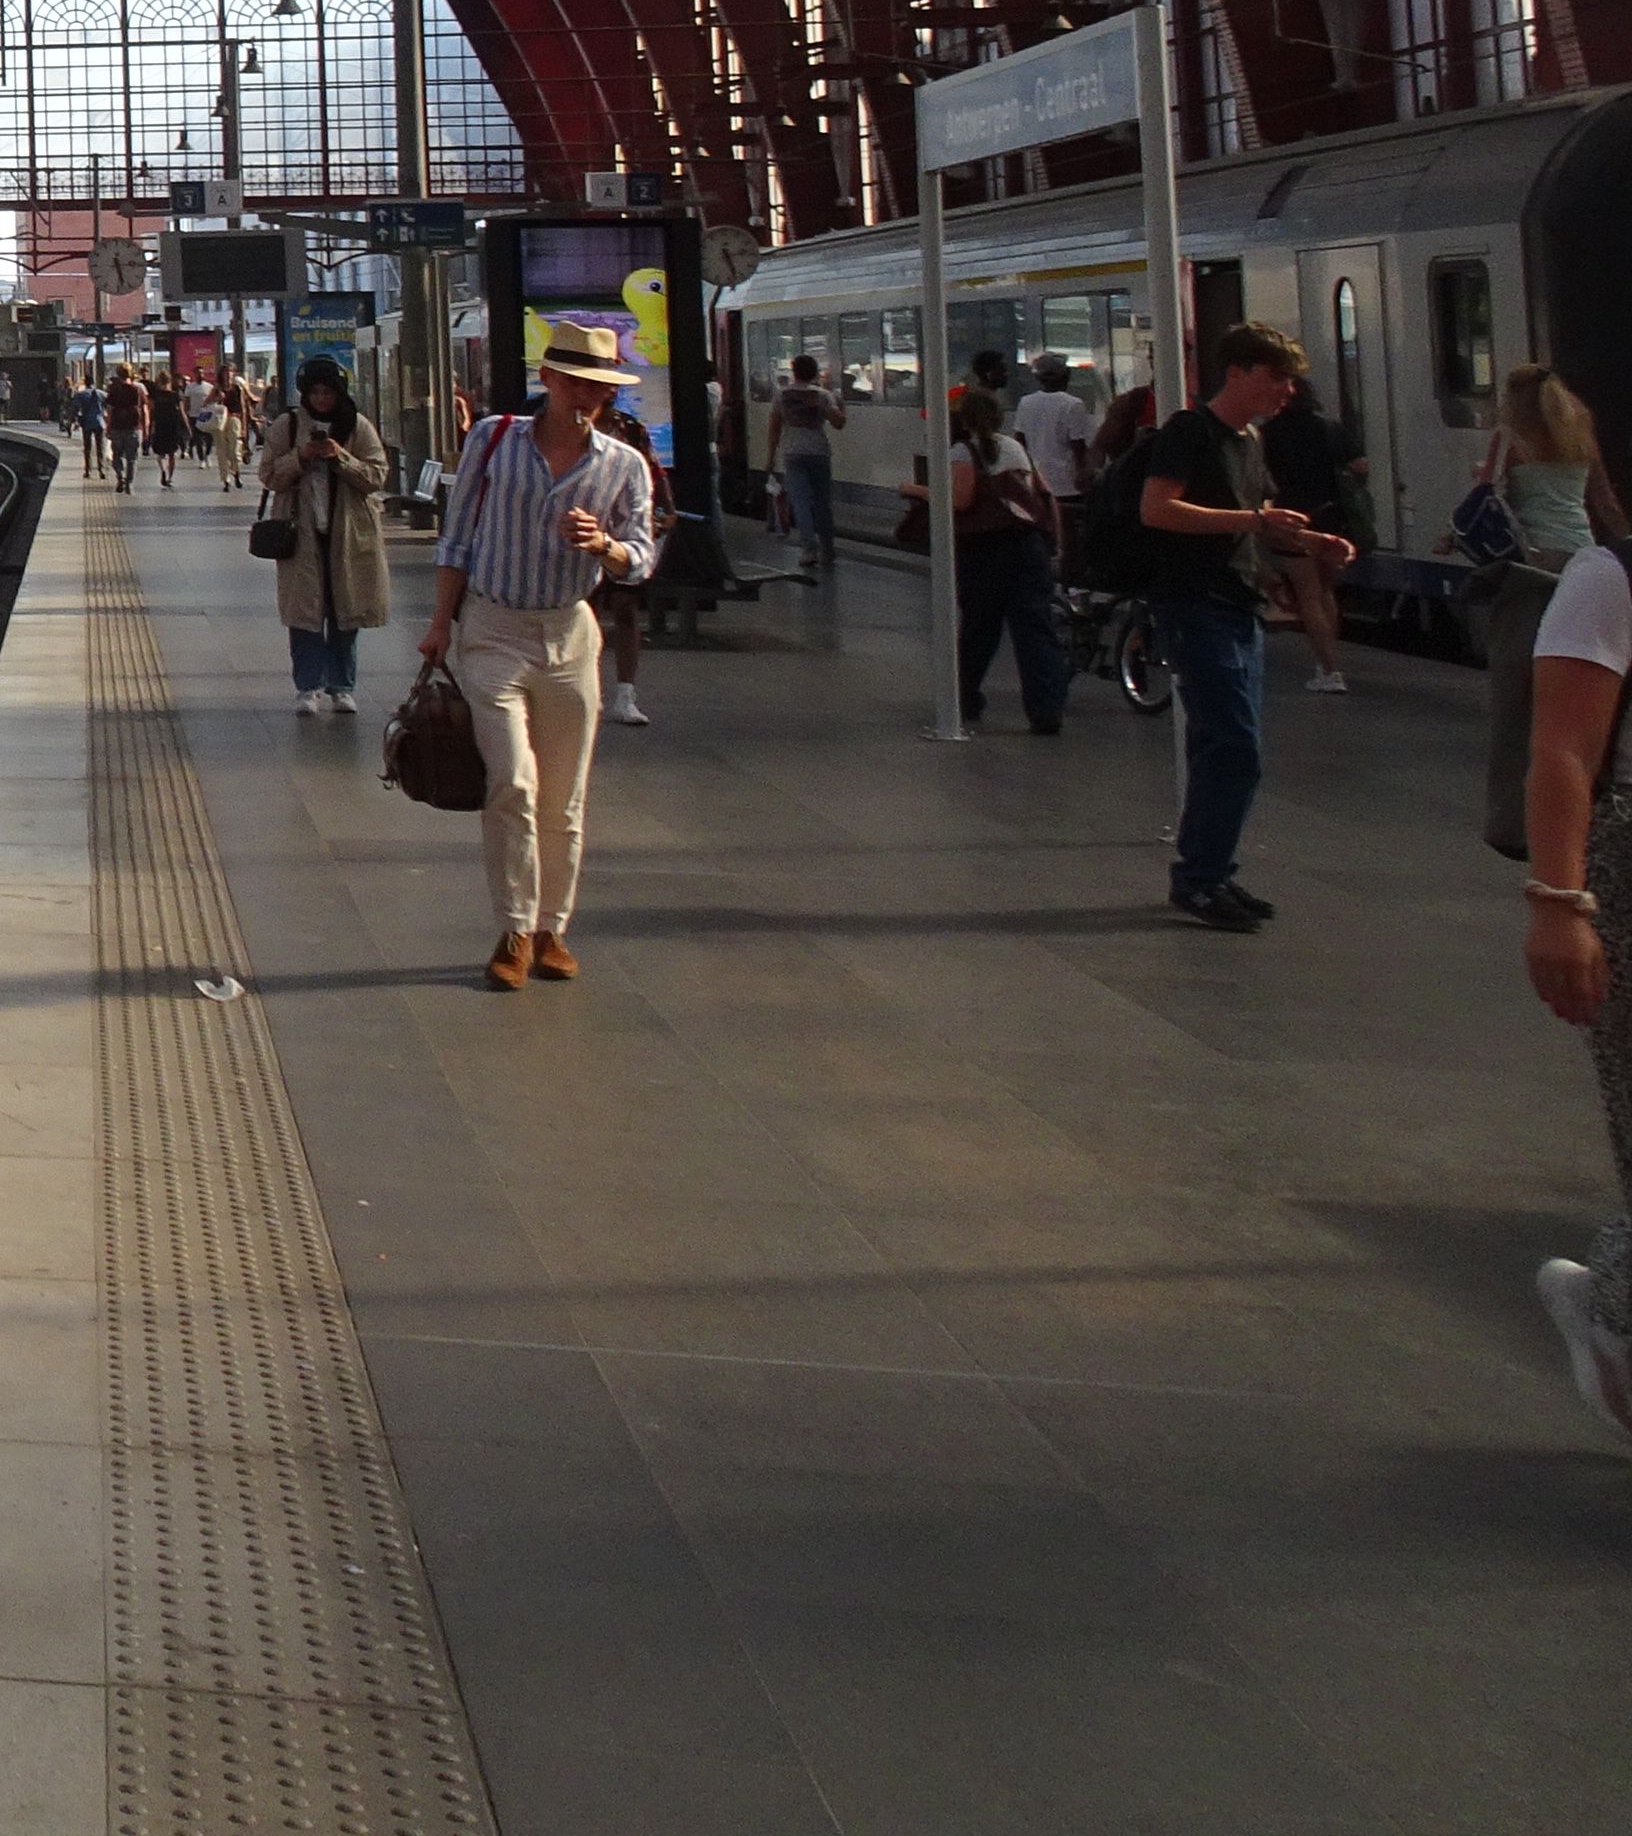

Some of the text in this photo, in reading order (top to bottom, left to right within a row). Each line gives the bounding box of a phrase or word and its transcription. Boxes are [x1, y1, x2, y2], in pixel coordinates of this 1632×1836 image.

[946, 97, 1020, 146] Antwerpen
[1036, 60, 1107, 121] Centraal
[603, 186, 613, 198] A
[639, 185, 648, 199] 2
[184, 194, 193, 207] 3
[217, 194, 228, 206] A
[290, 316, 357, 329] Bruisend
